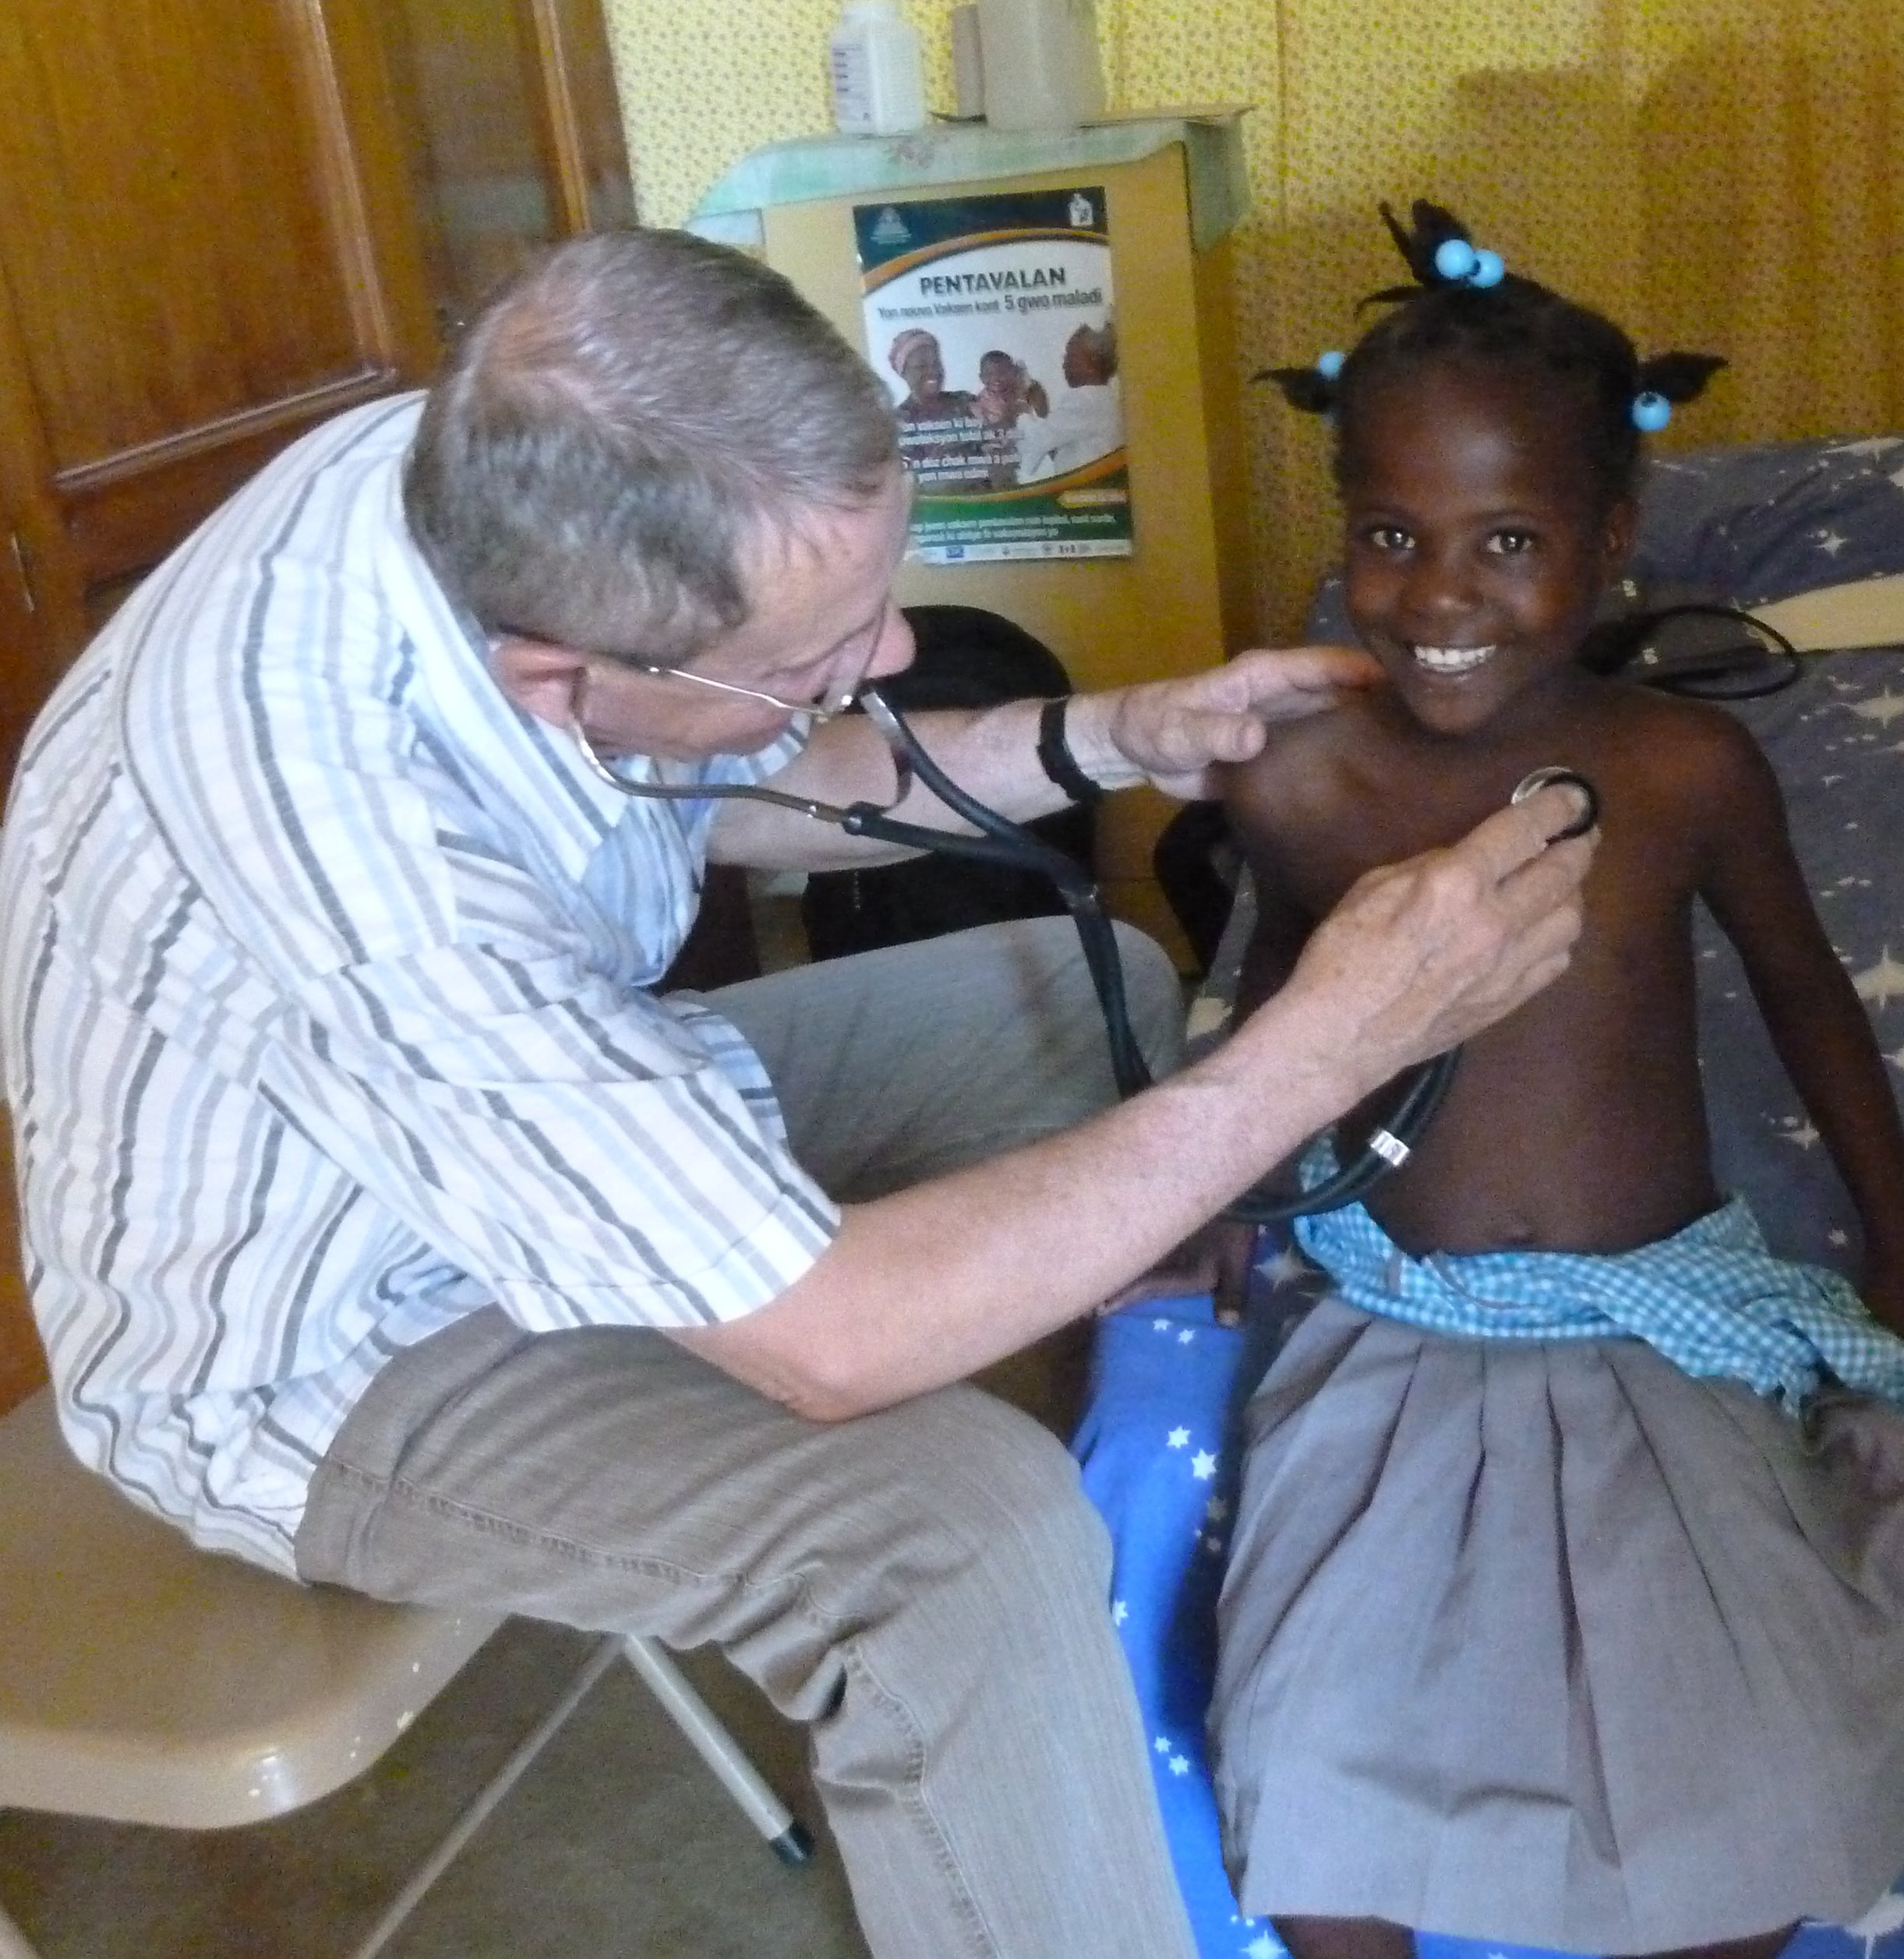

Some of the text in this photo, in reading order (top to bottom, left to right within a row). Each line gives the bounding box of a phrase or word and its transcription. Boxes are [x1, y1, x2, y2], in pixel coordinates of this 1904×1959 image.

[919, 266, 1066, 297] PENTAVALAN
[1004, 295, 1015, 310] 5
[1016, 295, 1050, 315] gwo
[1052, 287, 1103, 306] maladi
